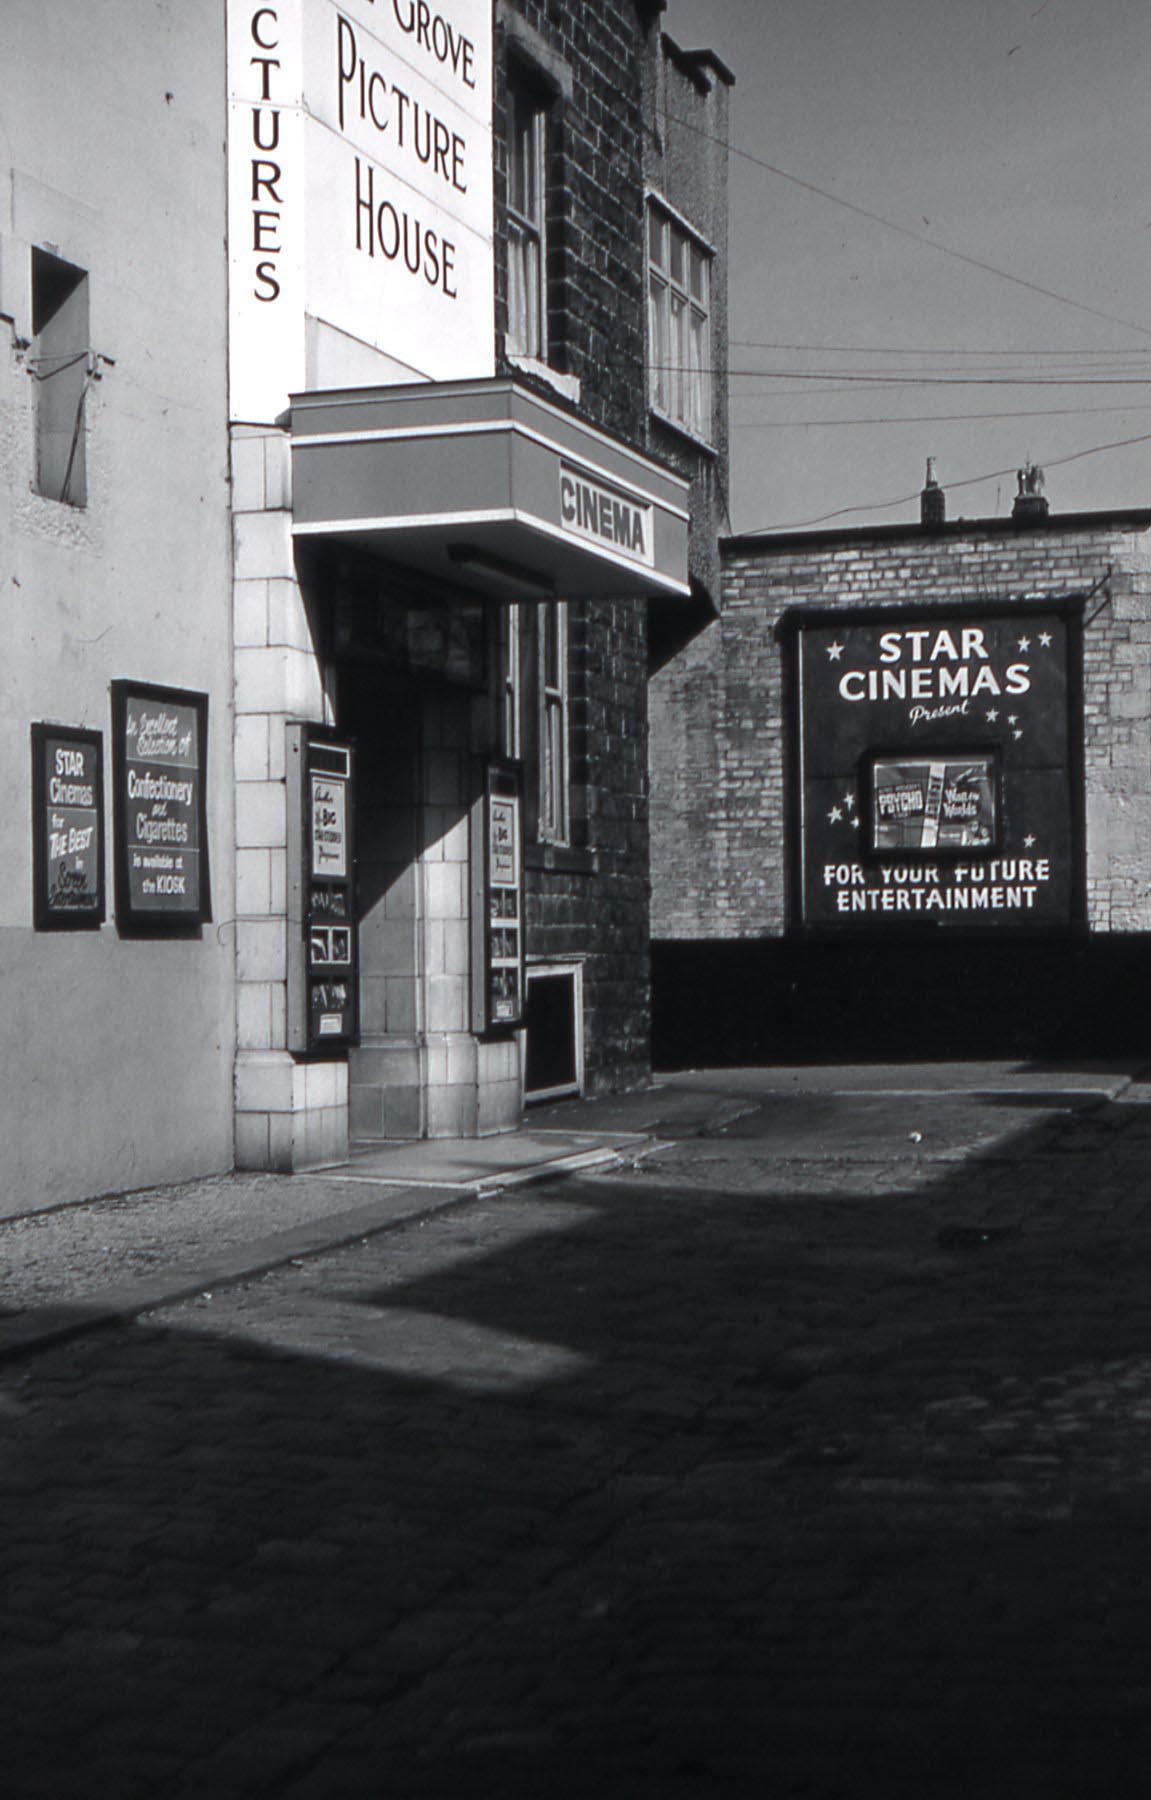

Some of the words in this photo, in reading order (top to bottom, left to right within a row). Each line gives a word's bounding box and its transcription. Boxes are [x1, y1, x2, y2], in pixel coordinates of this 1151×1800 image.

[337, 13, 467, 194] PICTURE
[250, 0, 284, 302] CTURES
[355, 156, 457, 299] HOUSE
[561, 476, 645, 555] CINEMA
[879, 628, 989, 663] STAR
[838, 663, 1031, 701] CINEMAS
[909, 699, 970, 727] Present
[55, 748, 84, 777] STAR
[50, 777, 93, 806] Cinemas
[878, 790, 923, 816] PSYCHO
[51, 813, 64, 829] for
[136, 812, 187, 844] Cigarettes
[49, 832, 68, 860] THE
[68, 826, 94, 854] BEST
[175, 855, 184, 869] at
[823, 864, 866, 886] FOR
[881, 865, 940, 884] YOUR
[954, 859, 1050, 883] FUTURE
[156, 874, 186, 895] KIOSK
[836, 886, 1038, 912] ENTERTAINMENT
